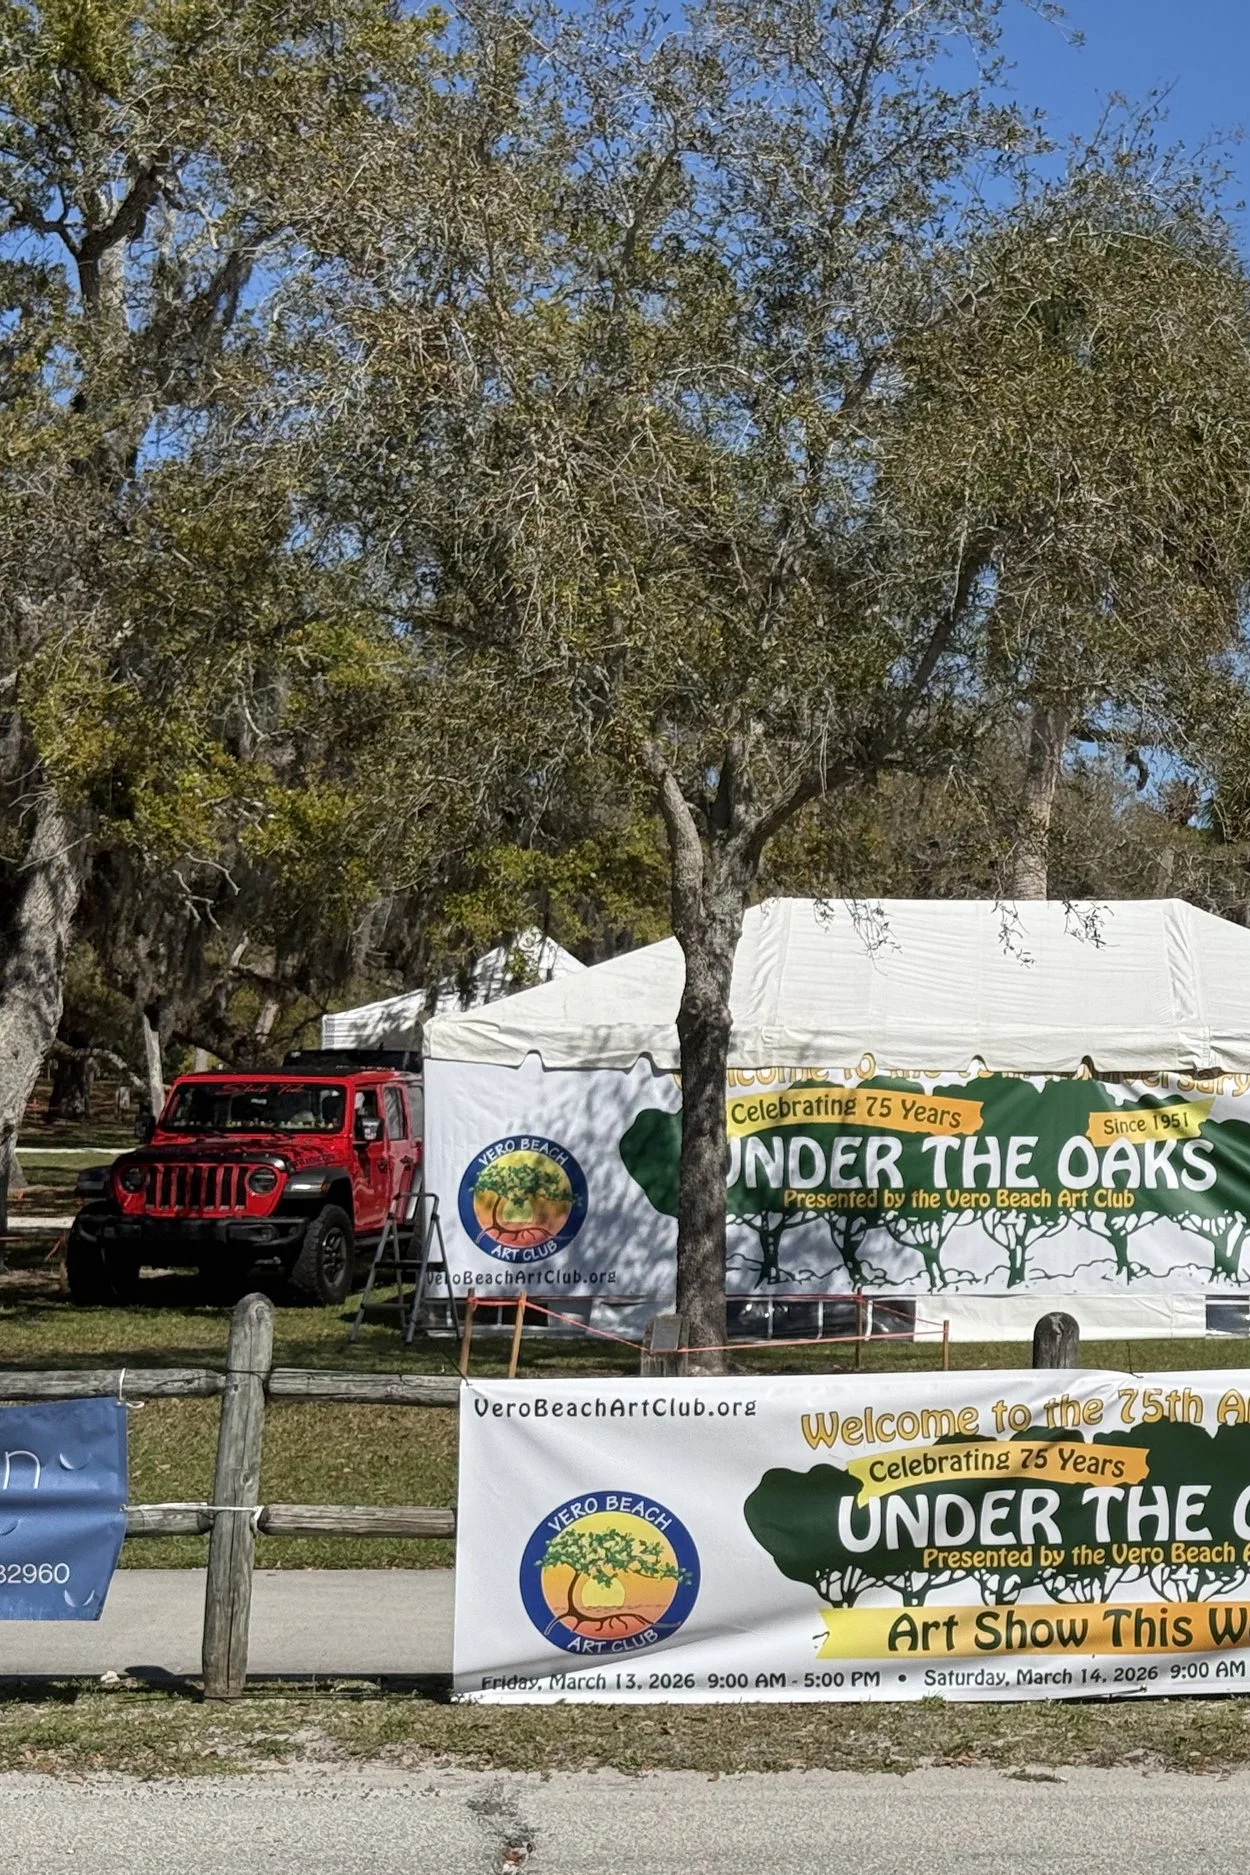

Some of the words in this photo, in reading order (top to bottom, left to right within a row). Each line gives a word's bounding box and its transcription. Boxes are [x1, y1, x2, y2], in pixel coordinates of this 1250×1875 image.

[731, 1095, 856, 1125] Celebrating
[865, 1096, 892, 1118] 75
[901, 1099, 961, 1129] Years
[1103, 1117, 1146, 1135] Since
[1154, 1112, 1188, 1131] 1951
[478, 1139, 515, 1167] VERO
[520, 1138, 569, 1167] BEACH
[921, 1136, 1040, 1189] THE
[1057, 1135, 1218, 1191] OAKS
[784, 1189, 877, 1208] Presented
[884, 1189, 905, 1208] by
[912, 1189, 940, 1208] the
[945, 1188, 991, 1208] Vero
[996, 1188, 1051, 1208] Beach
[1057, 1188, 1088, 1208] Art
[1093, 1188, 1135, 1209] Club
[491, 1244, 520, 1261] ART
[523, 1240, 558, 1261] CLUB
[474, 1398, 757, 1417] VeroBeachArtClub.org
[801, 1406, 979, 1450] Welcome
[991, 1399, 1032, 1433] to
[1045, 1394, 1103, 1427] the
[1117, 1388, 1203, 1424] 75th
[869, 1448, 1010, 1482] Celebrating
[1021, 1447, 1048, 1469] 75
[1058, 1448, 1125, 1478] Years
[548, 1497, 598, 1532] VERO
[605, 1495, 672, 1531] BEACH
[838, 1488, 1062, 1552] UNDER
[1082, 1484, 1213, 1543] THE
[923, 1545, 1032, 1569] Presented
[1040, 1545, 1065, 1568] by
[1071, 1545, 1105, 1566] the
[1112, 1543, 1164, 1565] Vero
[1171, 1541, 1236, 1564] Beach
[567, 1636, 606, 1654] ART
[611, 1629, 658, 1652] CLUB
[887, 1612, 958, 1652] Art
[974, 1611, 1089, 1650] Show
[1102, 1607, 1194, 1649] This
[482, 1675, 542, 1692] Friday,
[550, 1672, 606, 1690] March
[616, 1673, 642, 1691] 13,
[649, 1673, 696, 1689] 2026
[707, 1672, 748, 1688] 9:00
[755, 1671, 786, 1688] AM
[804, 1671, 844, 1688] 5:00
[852, 1671, 880, 1687] PM
[924, 1668, 1010, 1688] Saturday,
[1016, 1667, 1072, 1685] March
[1113, 1665, 1158, 1682] 2026
[1170, 1663, 1209, 1680] 9:00
[1215, 1661, 1245, 1678] AM
